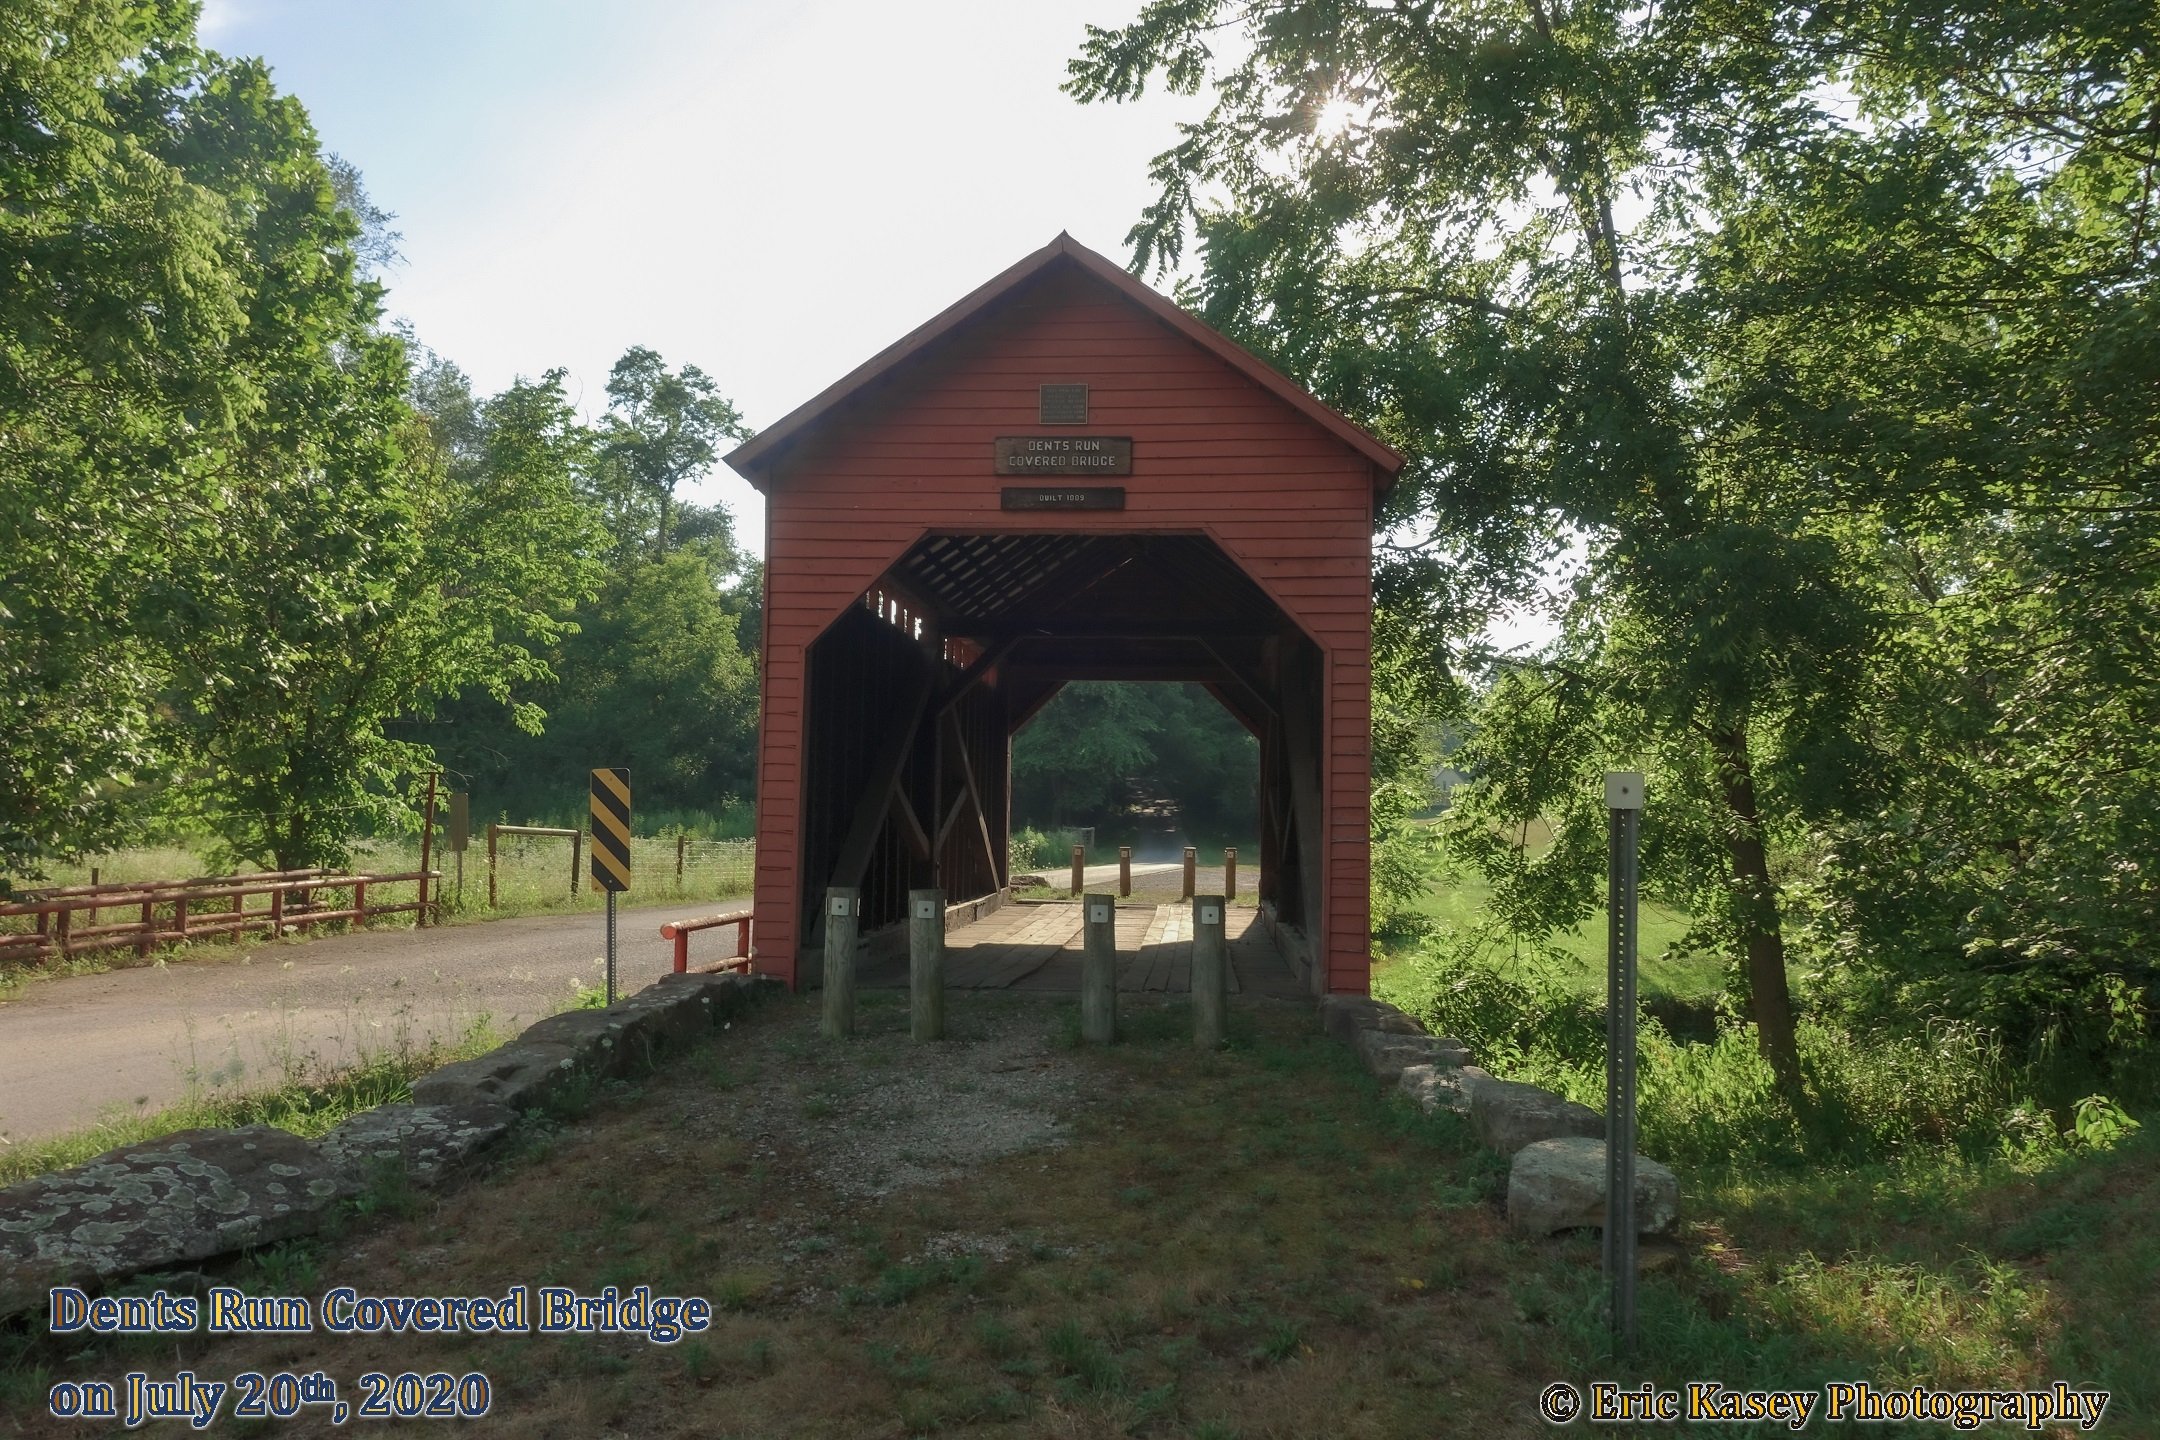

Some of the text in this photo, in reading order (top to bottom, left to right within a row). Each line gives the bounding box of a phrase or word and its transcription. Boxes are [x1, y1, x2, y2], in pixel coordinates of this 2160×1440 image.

[1028, 440, 1101, 451] DENTS RUN
[1009, 456, 1116, 466] COVERED BRIDGE
